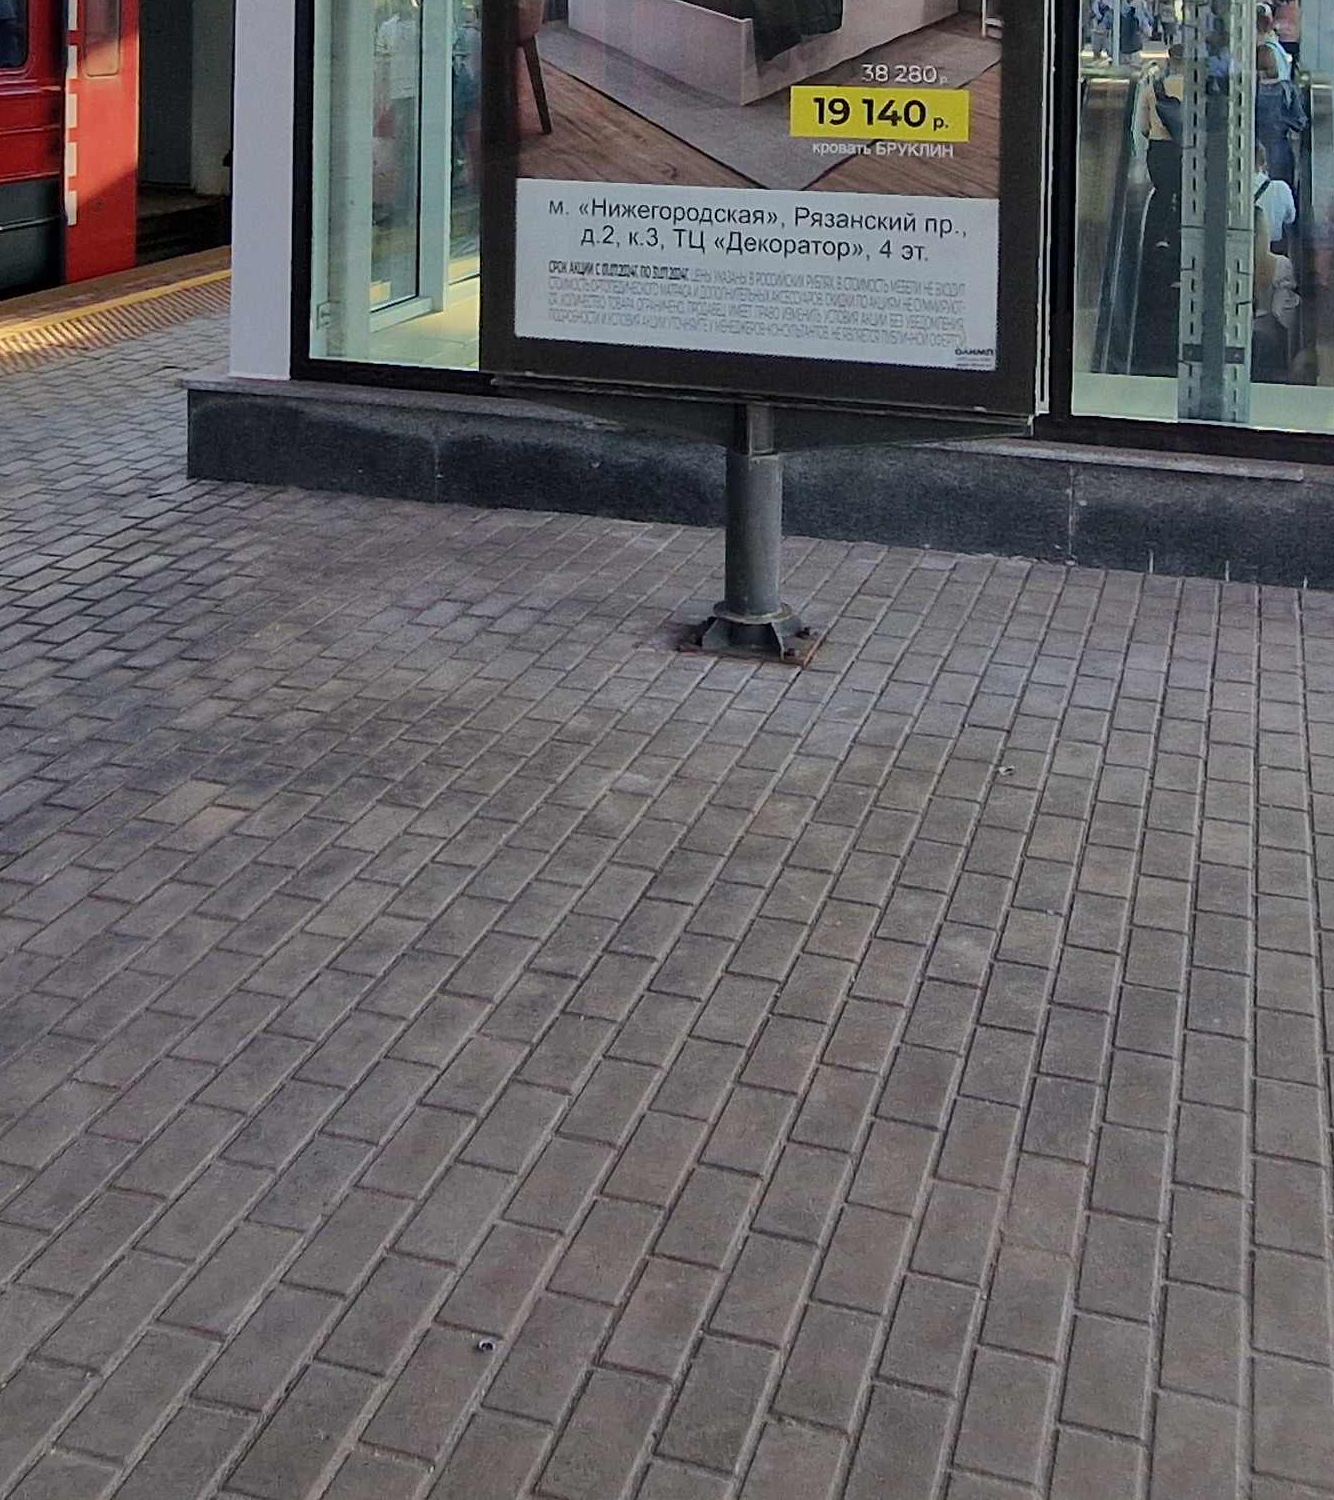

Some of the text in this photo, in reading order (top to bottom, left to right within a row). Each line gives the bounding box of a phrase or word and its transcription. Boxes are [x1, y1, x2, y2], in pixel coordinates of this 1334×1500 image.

[861, 64, 889, 82] 38
[894, 65, 938, 83] 280
[813, 97, 949, 131] 19 140 р.
[812, 141, 954, 158] кровать БРУКЛИН
[548, 198, 967, 238] м. «Нижегородская», Рязанский пр.,
[629, 227, 664, 250] к.3,
[672, 228, 706, 253] ТЦ
[714, 231, 870, 261] «Декоратор»,
[879, 240, 892, 259] 4
[901, 244, 928, 261] эт.
